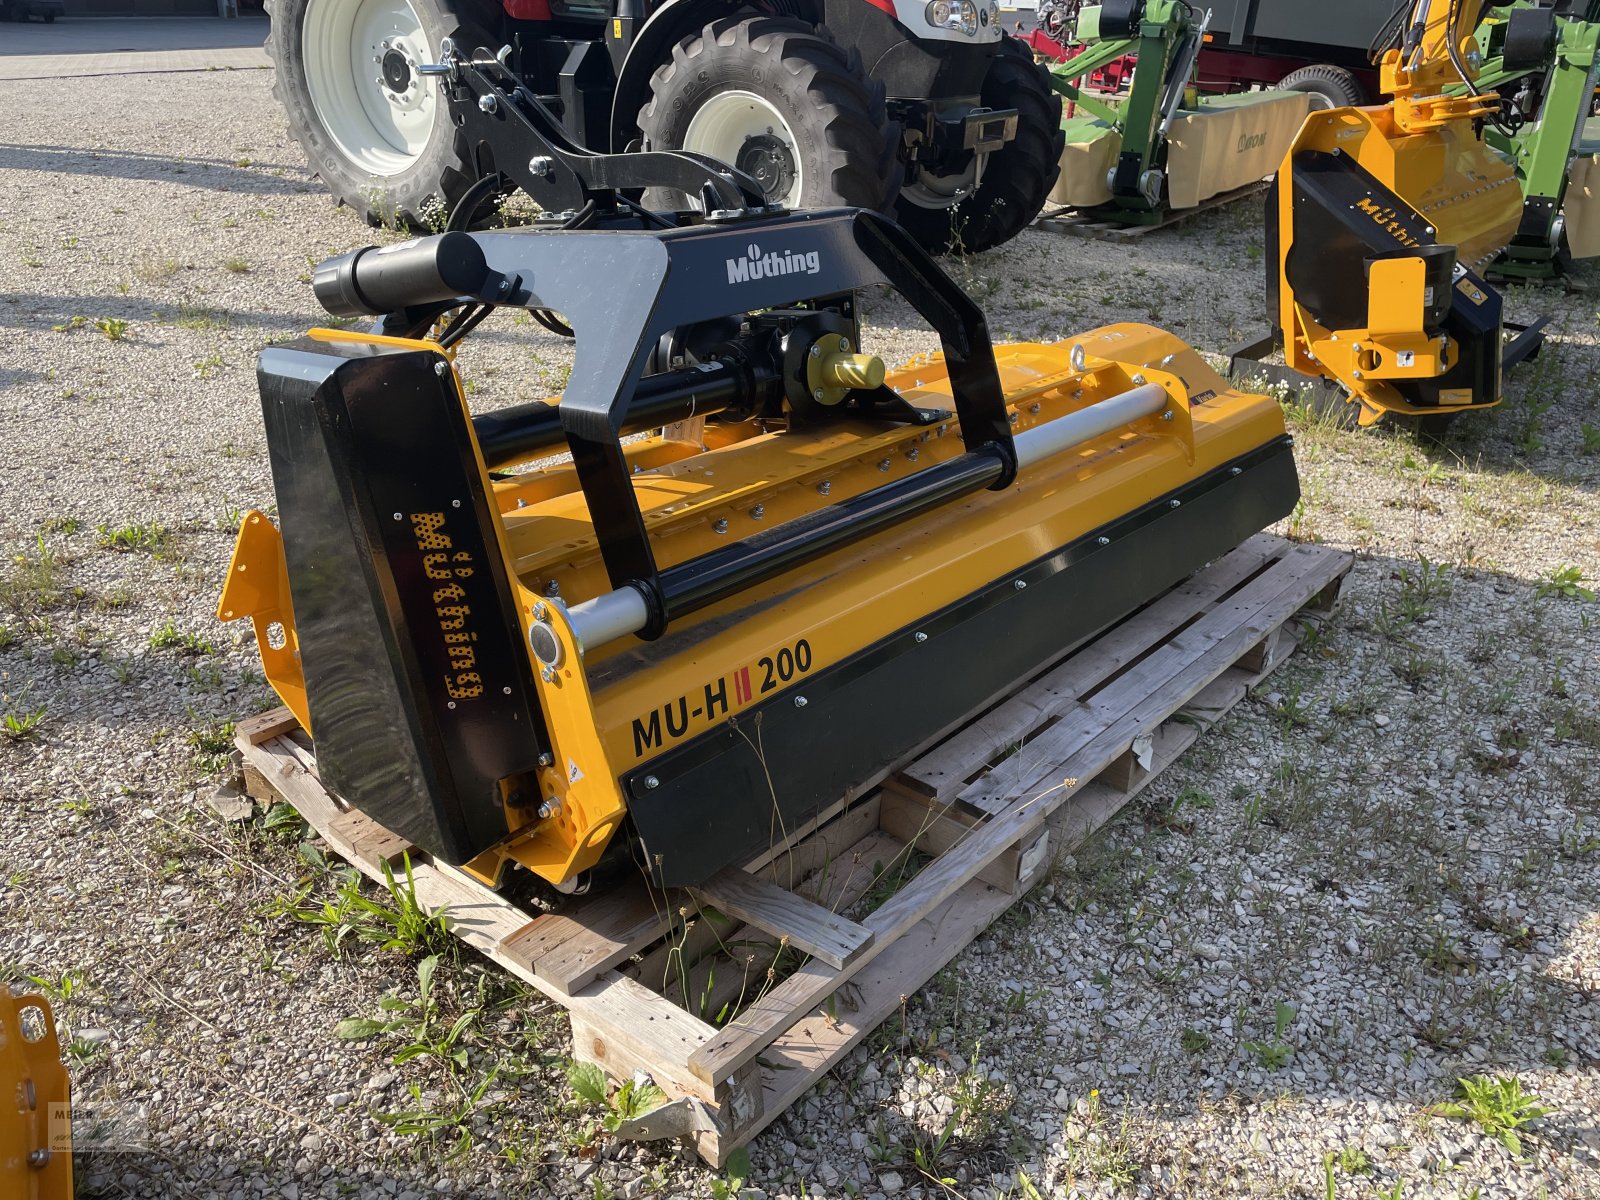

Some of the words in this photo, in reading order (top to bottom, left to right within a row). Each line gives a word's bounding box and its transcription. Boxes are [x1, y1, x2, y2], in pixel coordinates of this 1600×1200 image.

[725, 243, 821, 285] Müthing
[409, 511, 484, 700] Müthing
[631, 677, 728, 757] MU-H
[757, 638, 812, 694] 200
